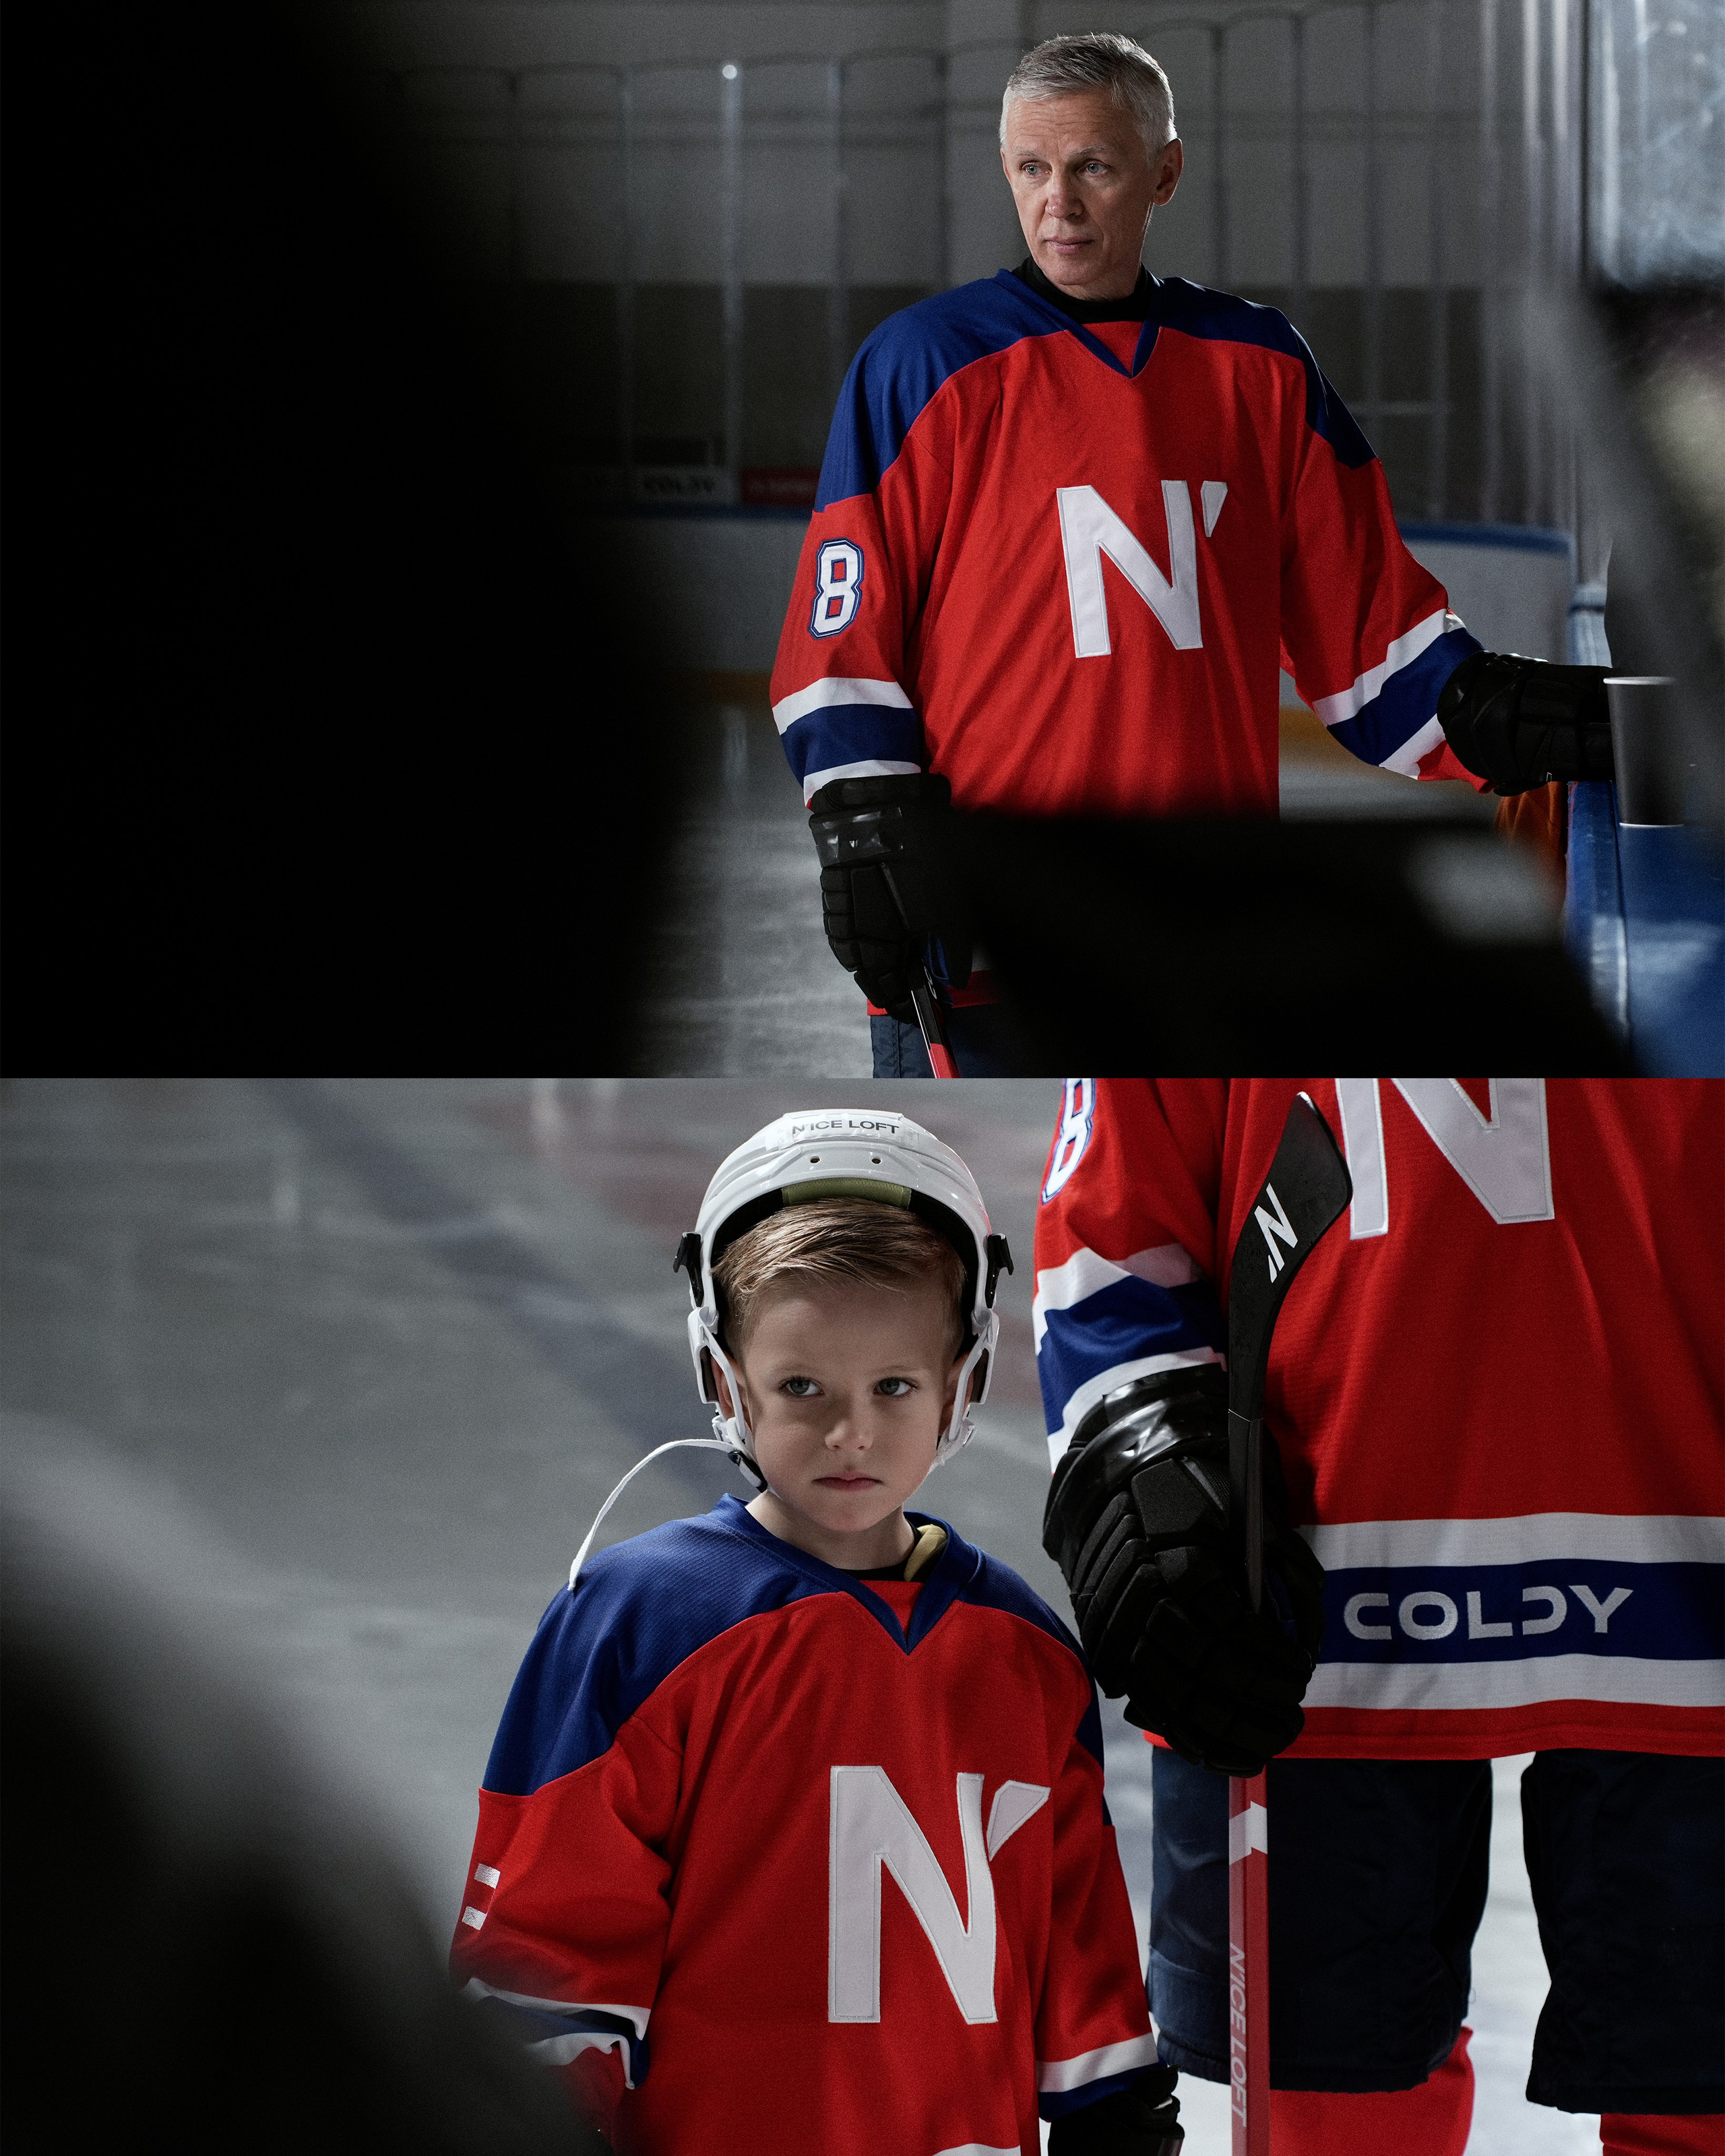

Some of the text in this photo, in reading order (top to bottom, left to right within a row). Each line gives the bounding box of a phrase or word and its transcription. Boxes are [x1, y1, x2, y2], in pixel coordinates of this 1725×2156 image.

[809, 537, 865, 640] 8
[848, 1120, 900, 1135] LOFT
[1042, 1078, 1096, 1205] 8
[1230, 2035, 1247, 2128] LOFT
